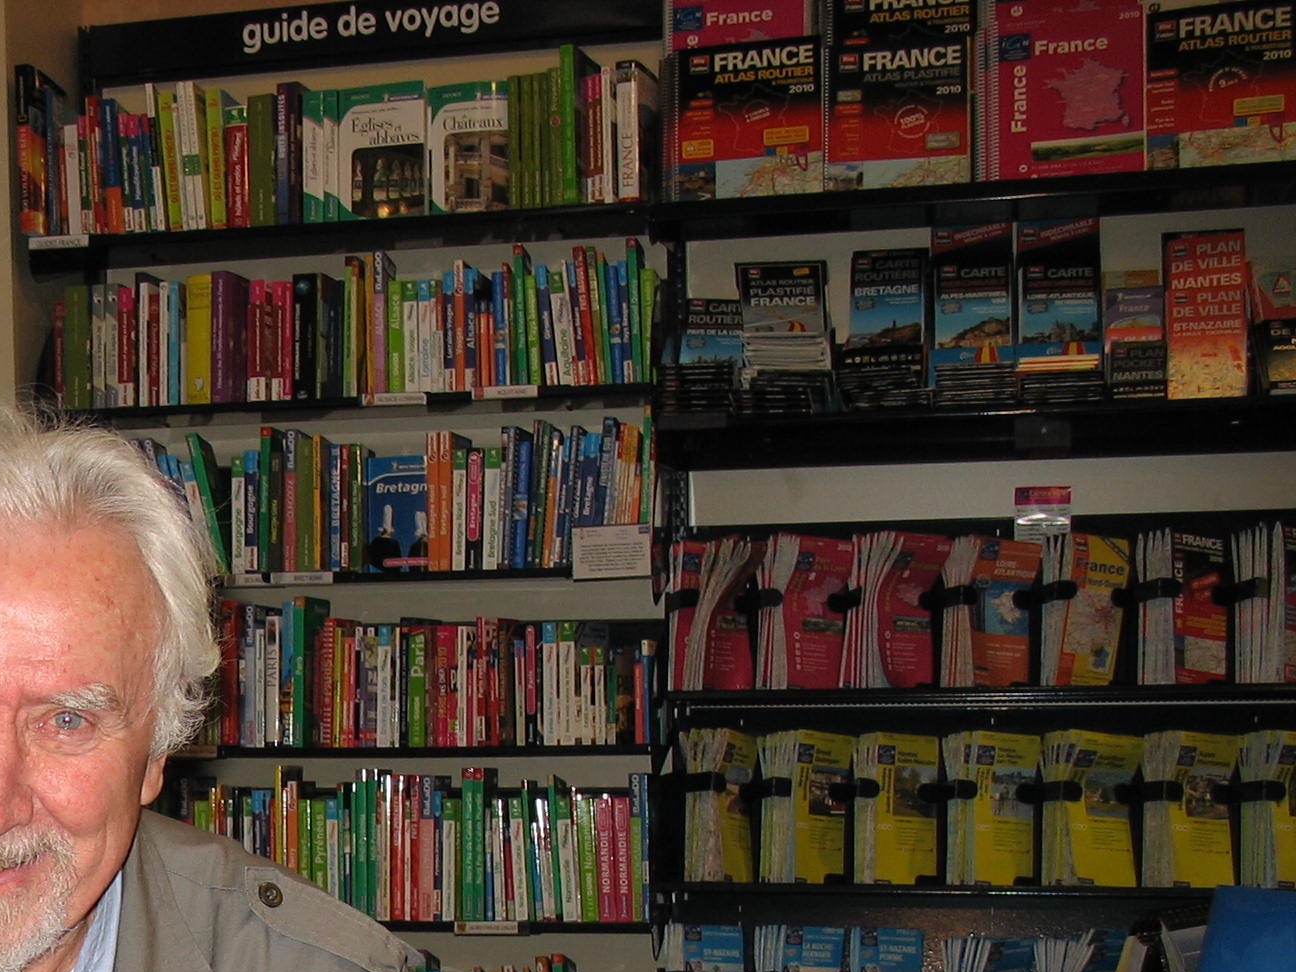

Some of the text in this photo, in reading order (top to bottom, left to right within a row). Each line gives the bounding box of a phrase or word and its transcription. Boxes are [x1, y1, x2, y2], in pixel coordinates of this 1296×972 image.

[705, 9, 773, 27] France
[869, 10, 912, 23] ATLAS
[913, 5, 970, 20] ROUTIER
[1179, 6, 1293, 39] FRANCE
[242, 0, 501, 55] guide de voyage
[943, 22, 970, 34] 2010
[1034, 36, 1108, 56] France
[1178, 29, 1294, 51] ATLAS ROUTIER
[714, 44, 814, 72] FRANCE
[863, 45, 962, 73] FRANCE
[1263, 48, 1292, 61] 2010
[714, 65, 814, 85] ATLAS ROUTIER
[863, 69, 901, 83] ATLAS
[788, 83, 815, 95] 2010
[935, 84, 962, 96] 2010
[1010, 64, 1028, 133] France
[442, 115, 505, 132] Châteaux
[623, 132, 634, 188] FRANCE
[1196, 240, 1241, 256] PLAN
[874, 258, 921, 270] CARTE
[960, 267, 1005, 279] CARTE
[1047, 267, 1095, 279] CARTE
[1171, 255, 1241, 273] DE VILLE
[854, 284, 920, 297] BRETAGNE
[1171, 273, 1242, 290] NANTES
[749, 296, 816, 307] FRANCE
[1196, 290, 1241, 303] PLAN
[1173, 303, 1241, 318] DE VILLE
[467, 312, 475, 349] Alsace
[1172, 318, 1242, 331] ST-NAZAIRE
[562, 328, 573, 378] Aquitaine
[1112, 369, 1163, 380] NANTES
[330, 468, 341, 527] BRETAGNE
[246, 485, 256, 535] Bourgogne
[1181, 532, 1223, 548] FRANCE
[411, 633, 425, 678] Paris
[267, 648, 279, 688] PARIS
[315, 813, 325, 864] Pyrénées
[601, 831, 610, 894] NORMANDIE
[619, 831, 628, 894] NORMANDIE
